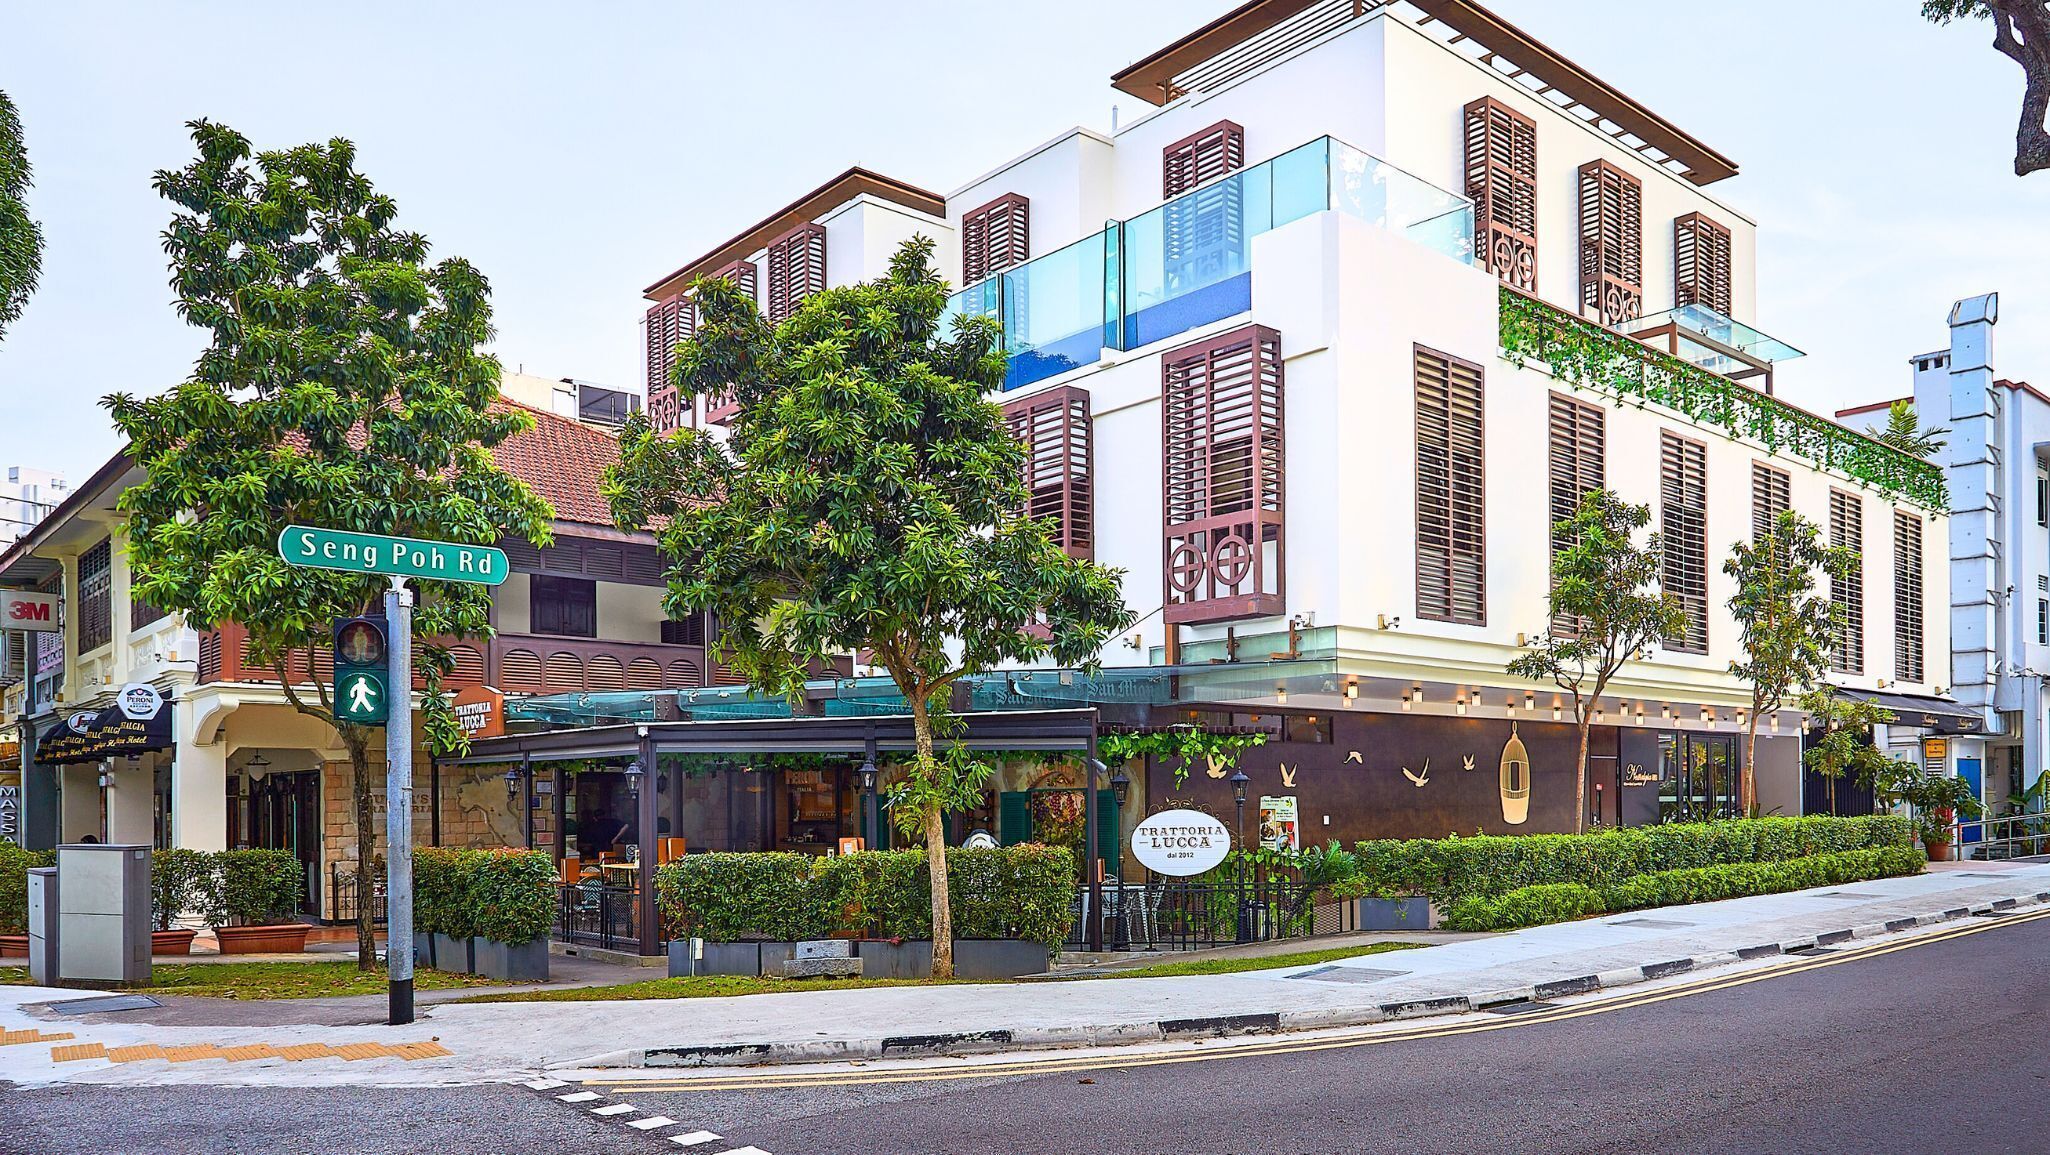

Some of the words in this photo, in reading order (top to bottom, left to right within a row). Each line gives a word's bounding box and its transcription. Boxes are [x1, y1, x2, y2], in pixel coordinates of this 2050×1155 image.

[300, 532, 378, 568] Seng
[392, 543, 445, 570] Poh
[459, 551, 492, 575] Rd
[9, 601, 50, 621] 3M
[455, 701, 492, 716] TRATTORIA
[1139, 826, 1224, 837] TRATTORIA
[1151, 836, 1213, 849] LUCCA
[1167, 851, 1178, 859] dal
[1178, 851, 1194, 859] 2012
